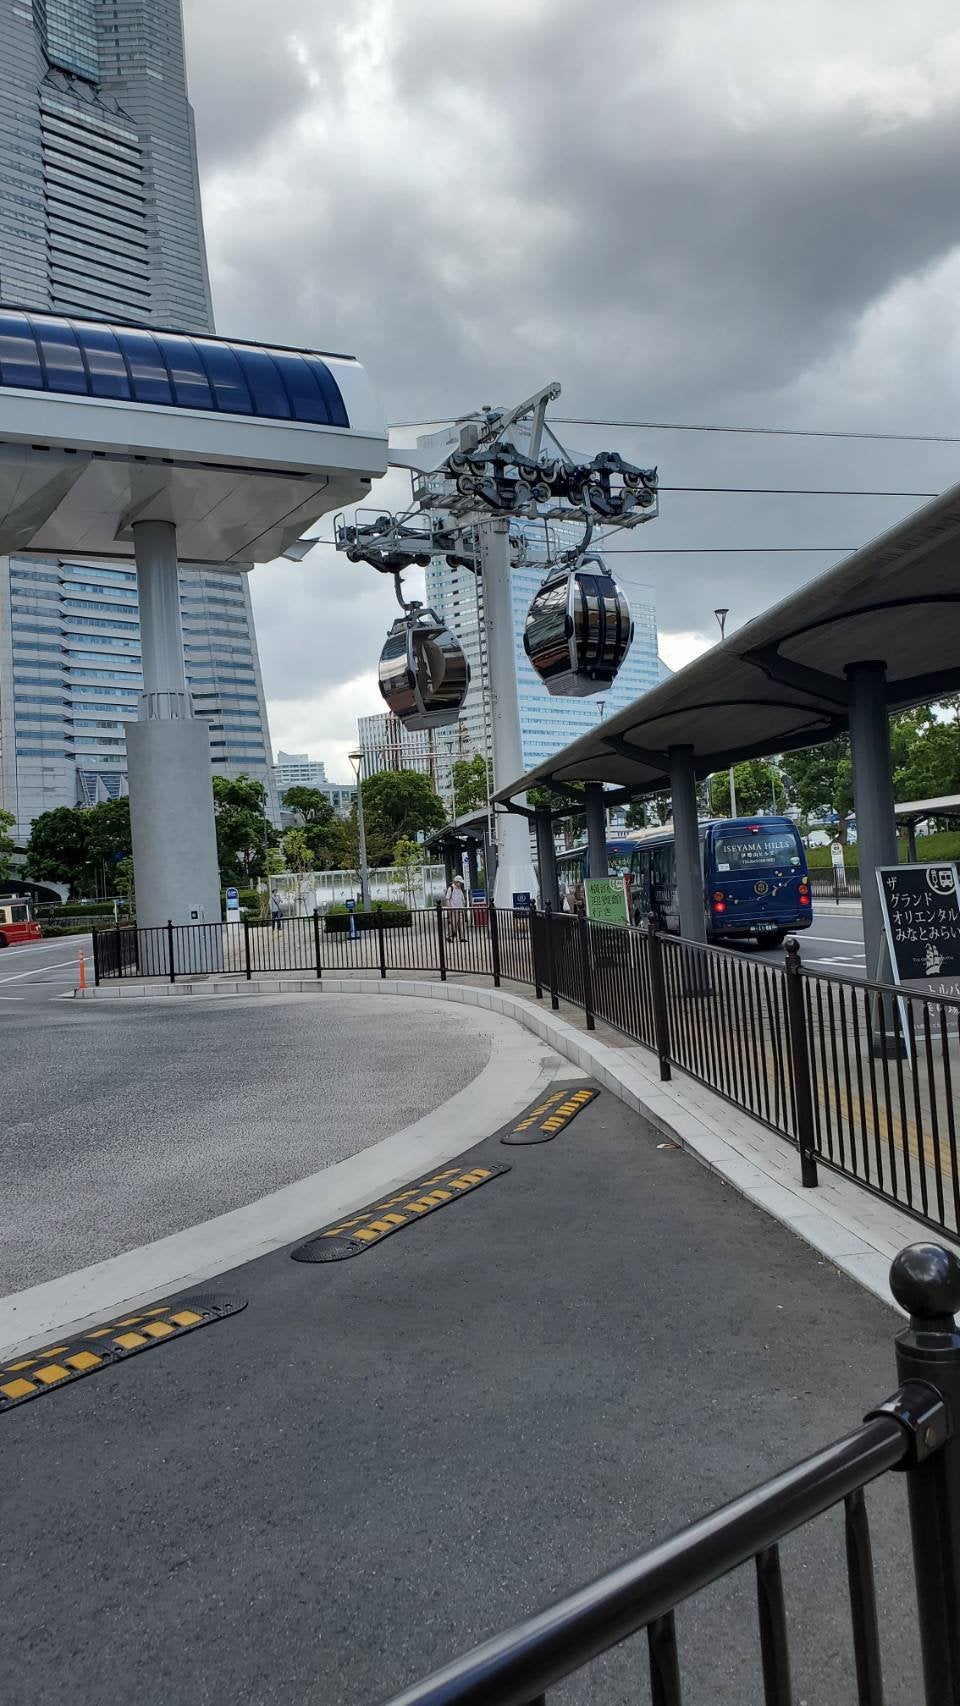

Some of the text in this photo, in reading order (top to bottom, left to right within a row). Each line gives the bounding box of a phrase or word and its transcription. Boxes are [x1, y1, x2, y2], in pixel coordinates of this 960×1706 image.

[723, 841, 789, 853] ISEYAMA HILLS
[886, 877, 897, 891] ザ
[890, 892, 933, 908] グランド
[893, 907, 959, 925] オリエンタル
[895, 926, 960, 943] みなとみらい
